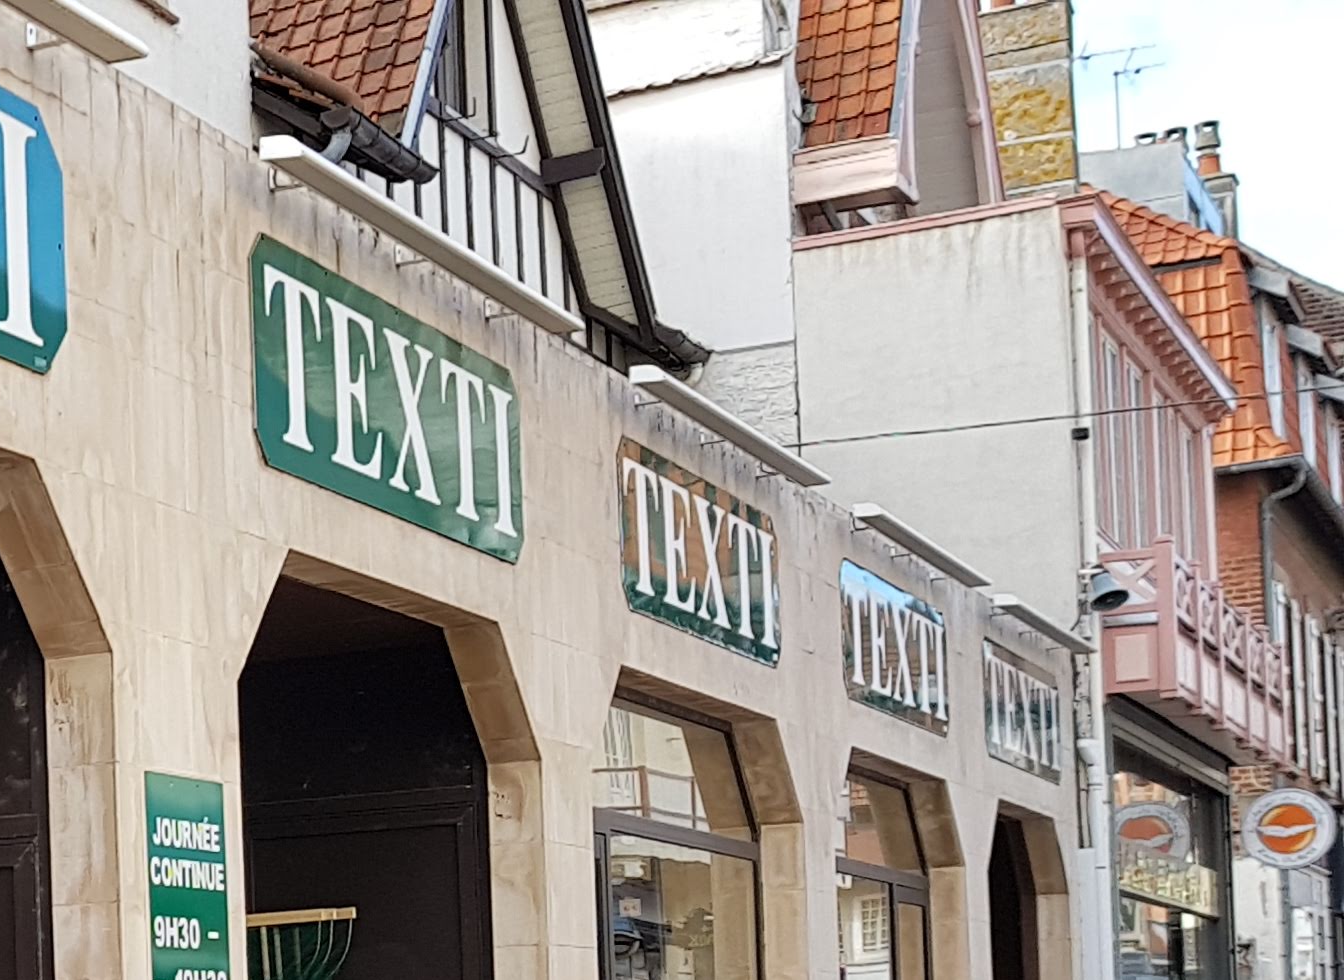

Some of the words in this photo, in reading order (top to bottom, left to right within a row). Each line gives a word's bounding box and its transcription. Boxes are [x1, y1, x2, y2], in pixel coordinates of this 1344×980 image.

[263, 263, 518, 538] TEXTI
[622, 456, 779, 649] TEXTI
[842, 580, 949, 721] TEXTI
[984, 652, 1061, 771] TEXTI
[150, 856, 225, 891] CONTINUE
[152, 816, 221, 852] JOURNÉE
[154, 915, 201, 949] 9H30
